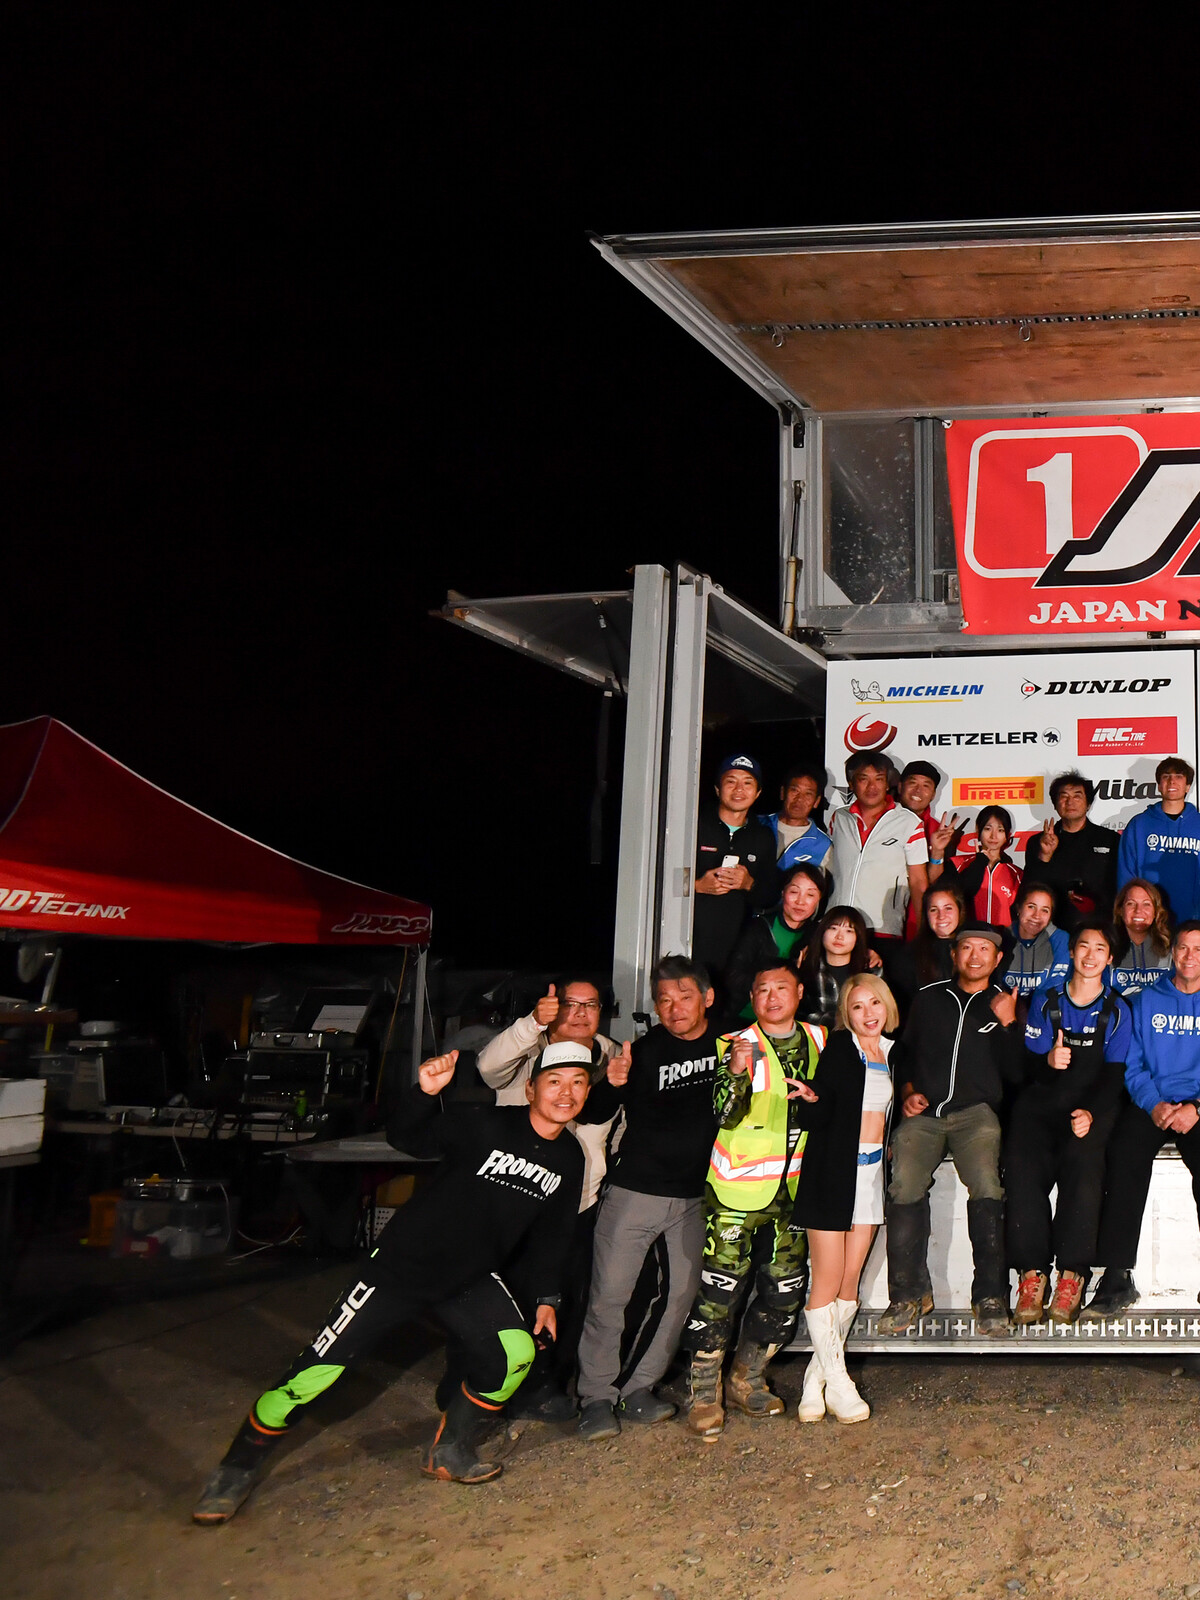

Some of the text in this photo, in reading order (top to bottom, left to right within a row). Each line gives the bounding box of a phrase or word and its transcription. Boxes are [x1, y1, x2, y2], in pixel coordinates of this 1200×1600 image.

[1026, 452, 1075, 555] 1
[1028, 599, 1168, 625] JAPAN
[886, 684, 985, 697] MICHELIN
[1044, 678, 1172, 696] DUNLOP
[918, 731, 1038, 747] METZELER
[1130, 732, 1147, 741] TIRE
[960, 782, 1036, 800] PIRELLI
[1086, 779, 1163, 800] Mita
[1160, 835, 1200, 851] YAMAHA
[331, 912, 430, 935] JNCC
[658, 1055, 717, 1091] FRONT
[476, 1149, 562, 1198] FRONTUP
[484, 1174, 510, 1188] ENJOY
